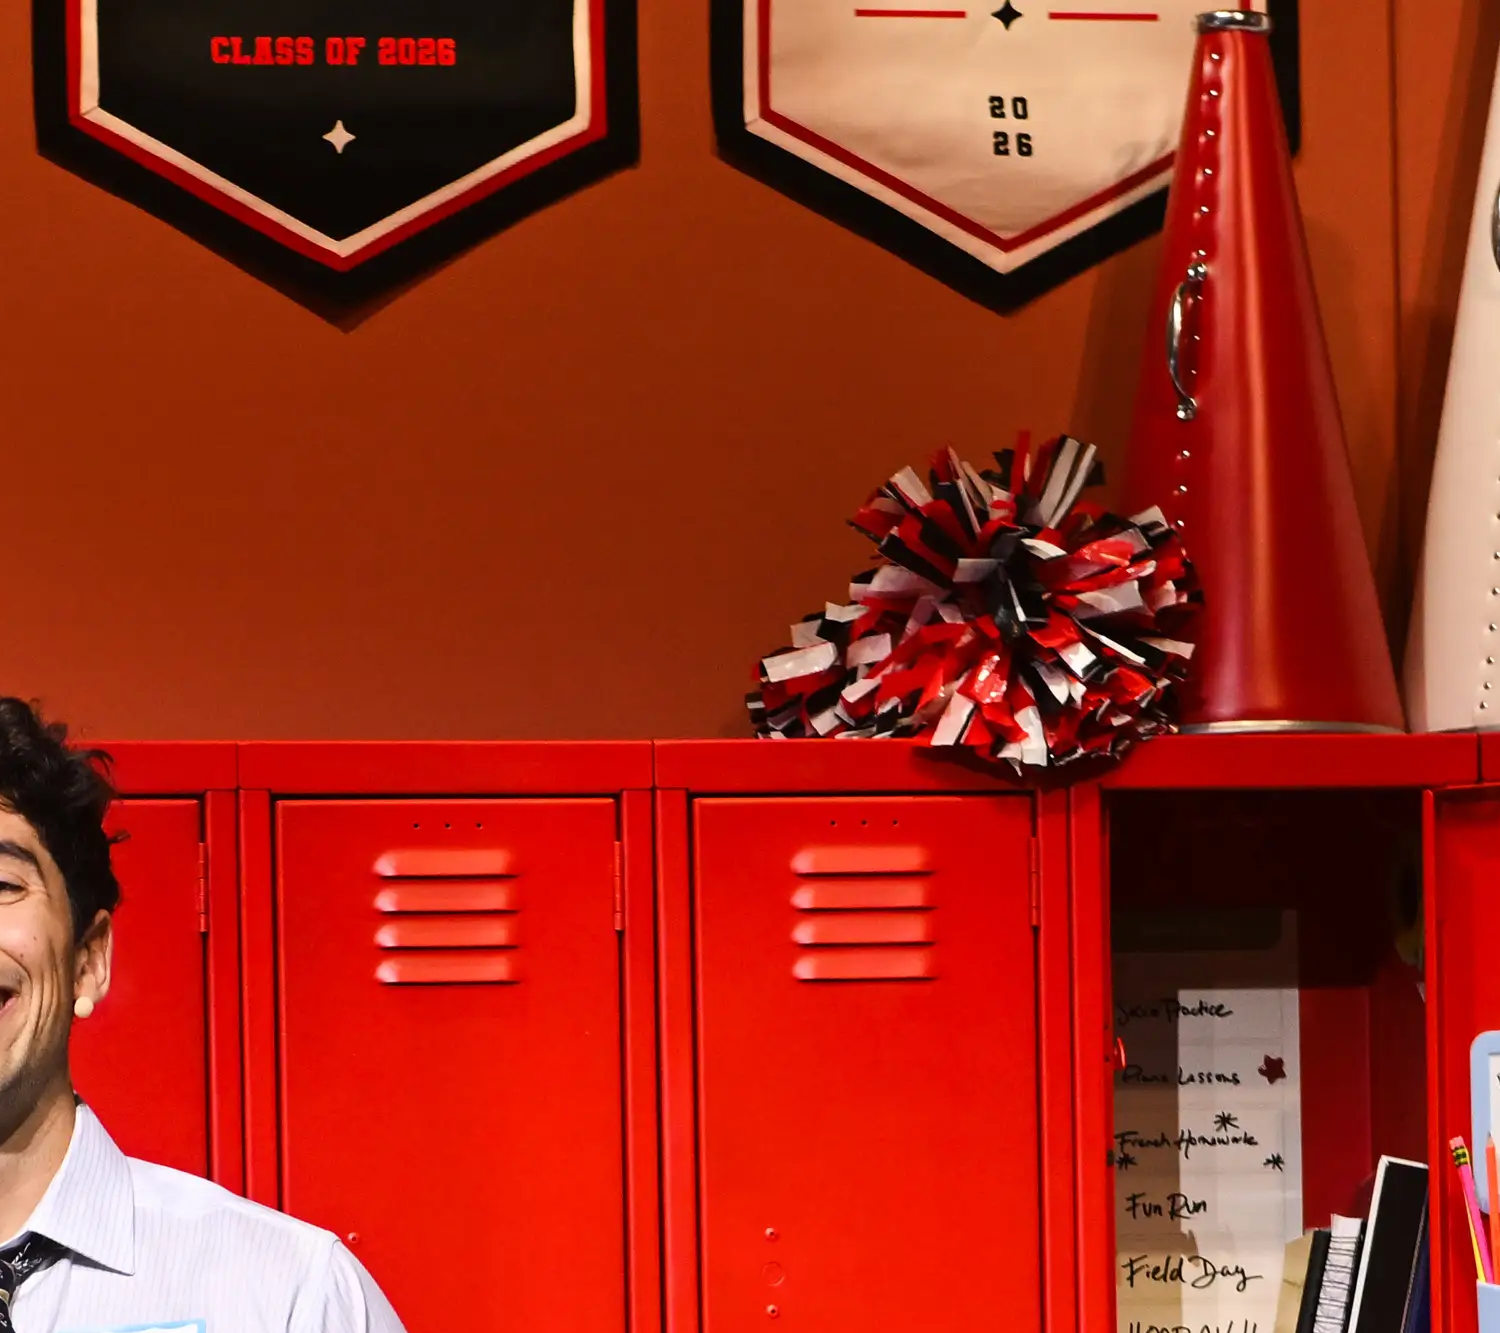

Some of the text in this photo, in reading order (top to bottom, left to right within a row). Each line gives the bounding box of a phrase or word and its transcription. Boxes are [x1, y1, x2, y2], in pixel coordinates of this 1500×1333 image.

[210, 36, 456, 66] CLASS OF 2026
[988, 95, 1028, 120] 20
[993, 131, 1033, 157] 26
[1114, 1129, 1258, 1159] French Homework
[1125, 1192, 1207, 1220] Fun Run
[1121, 1256, 1263, 1292] Field Day
